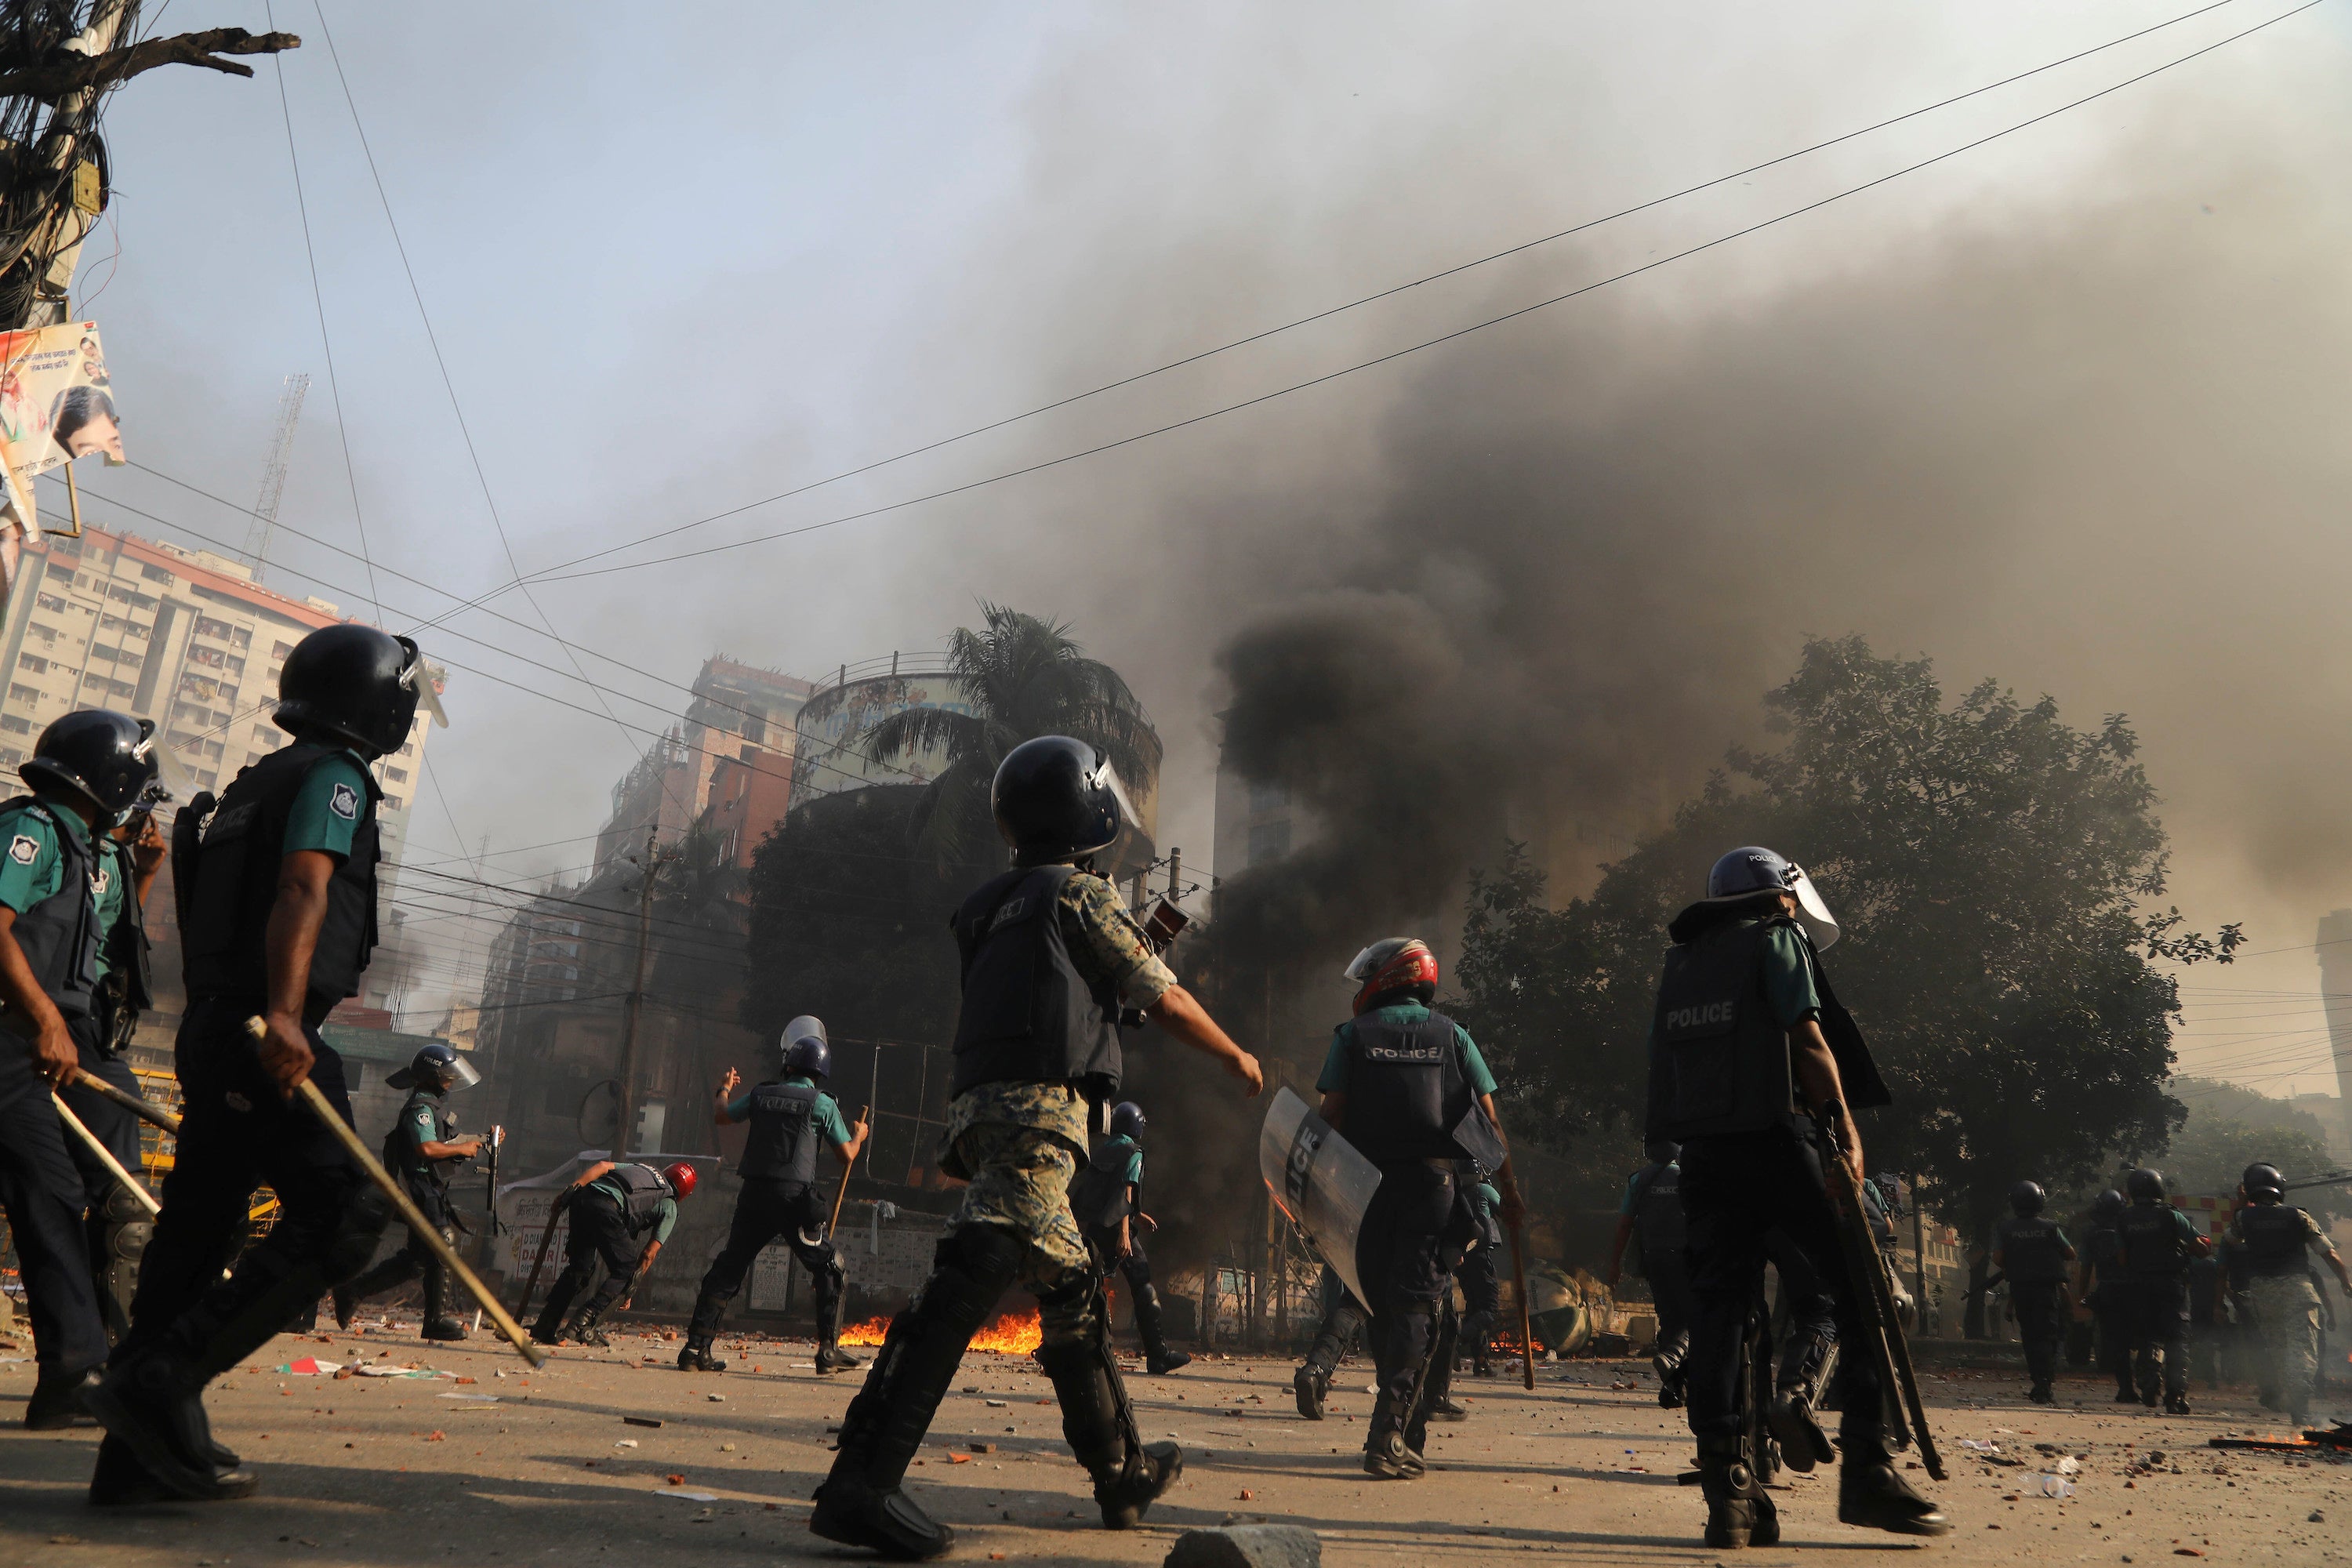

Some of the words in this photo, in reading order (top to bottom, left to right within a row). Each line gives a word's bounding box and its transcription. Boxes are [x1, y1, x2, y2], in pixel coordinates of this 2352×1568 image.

[1748, 855, 1778, 863] POLICE
[1667, 1000, 1733, 1030] POLICE
[1372, 1046, 1440, 1060] POLICE
[423, 1056, 443, 1067] POLICE
[760, 1097, 800, 1113] POLICE
[2012, 1229, 2047, 1239] POLICE
